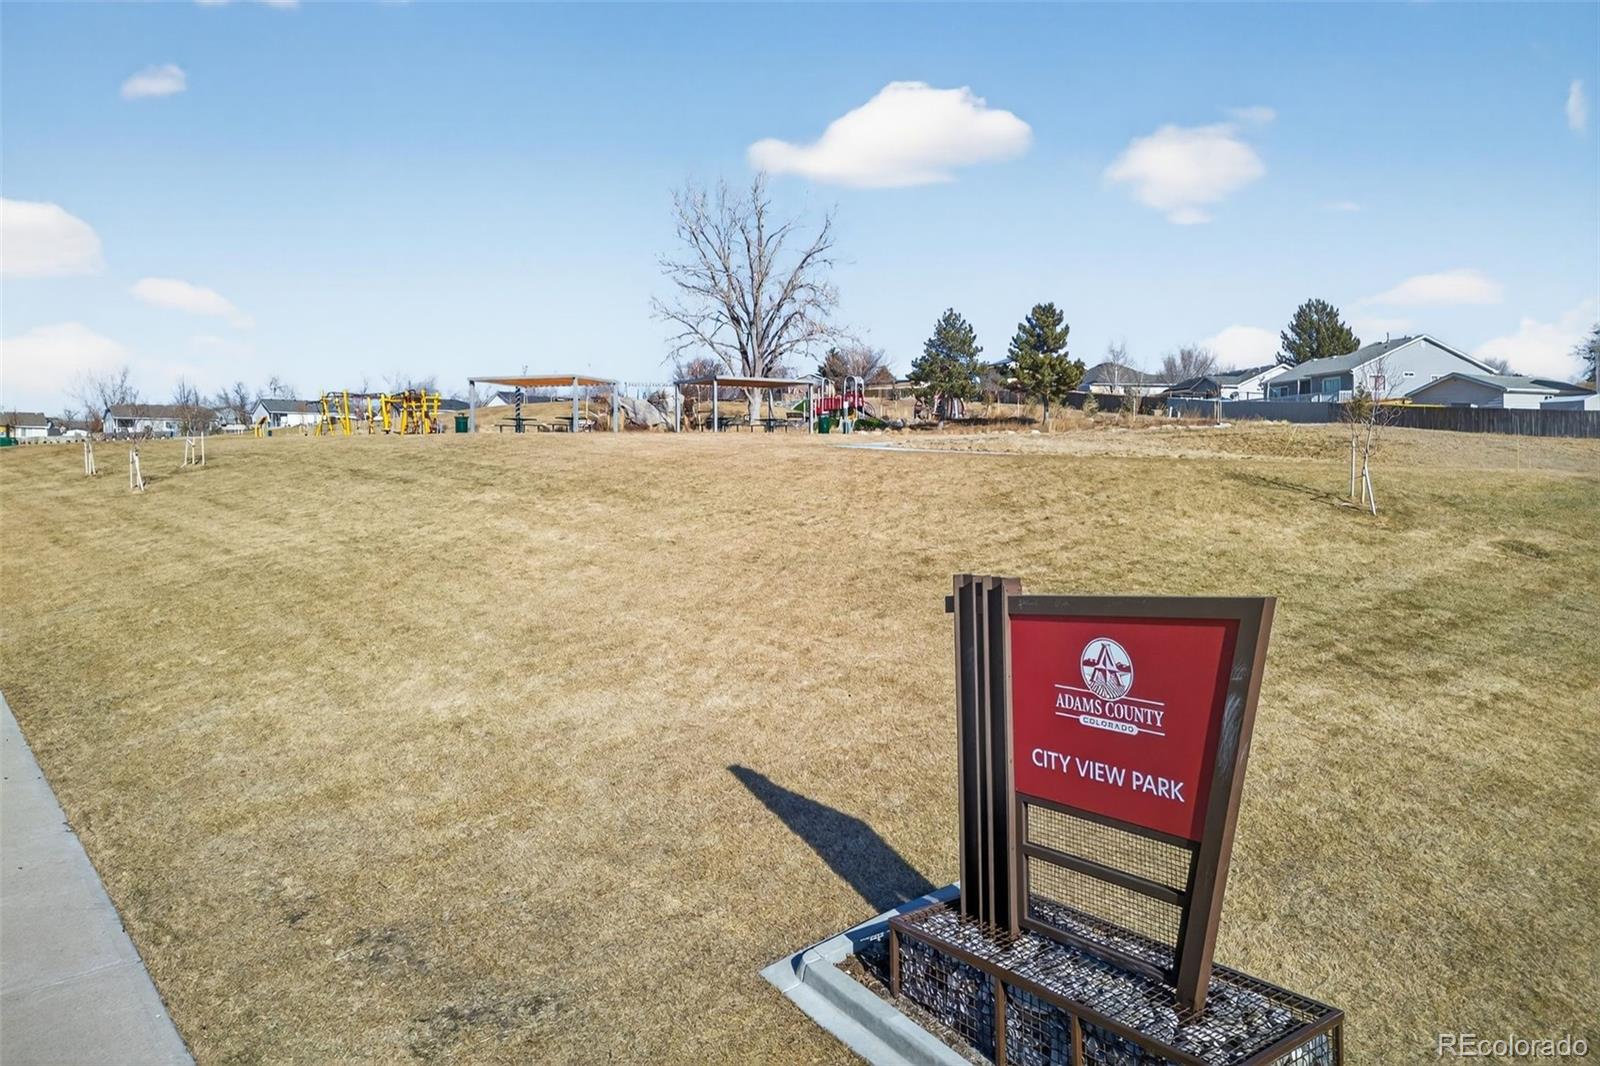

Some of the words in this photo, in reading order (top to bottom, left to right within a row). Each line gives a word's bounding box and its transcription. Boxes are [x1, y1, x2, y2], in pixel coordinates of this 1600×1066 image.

[1055, 693, 1102, 716] ADAMS
[1105, 702, 1164, 728] COUNTY
[1082, 716, 1135, 733] COLORADO
[1031, 748, 1072, 773] CITY
[1075, 757, 1126, 787] VIEW
[1132, 771, 1185, 802] PARK
